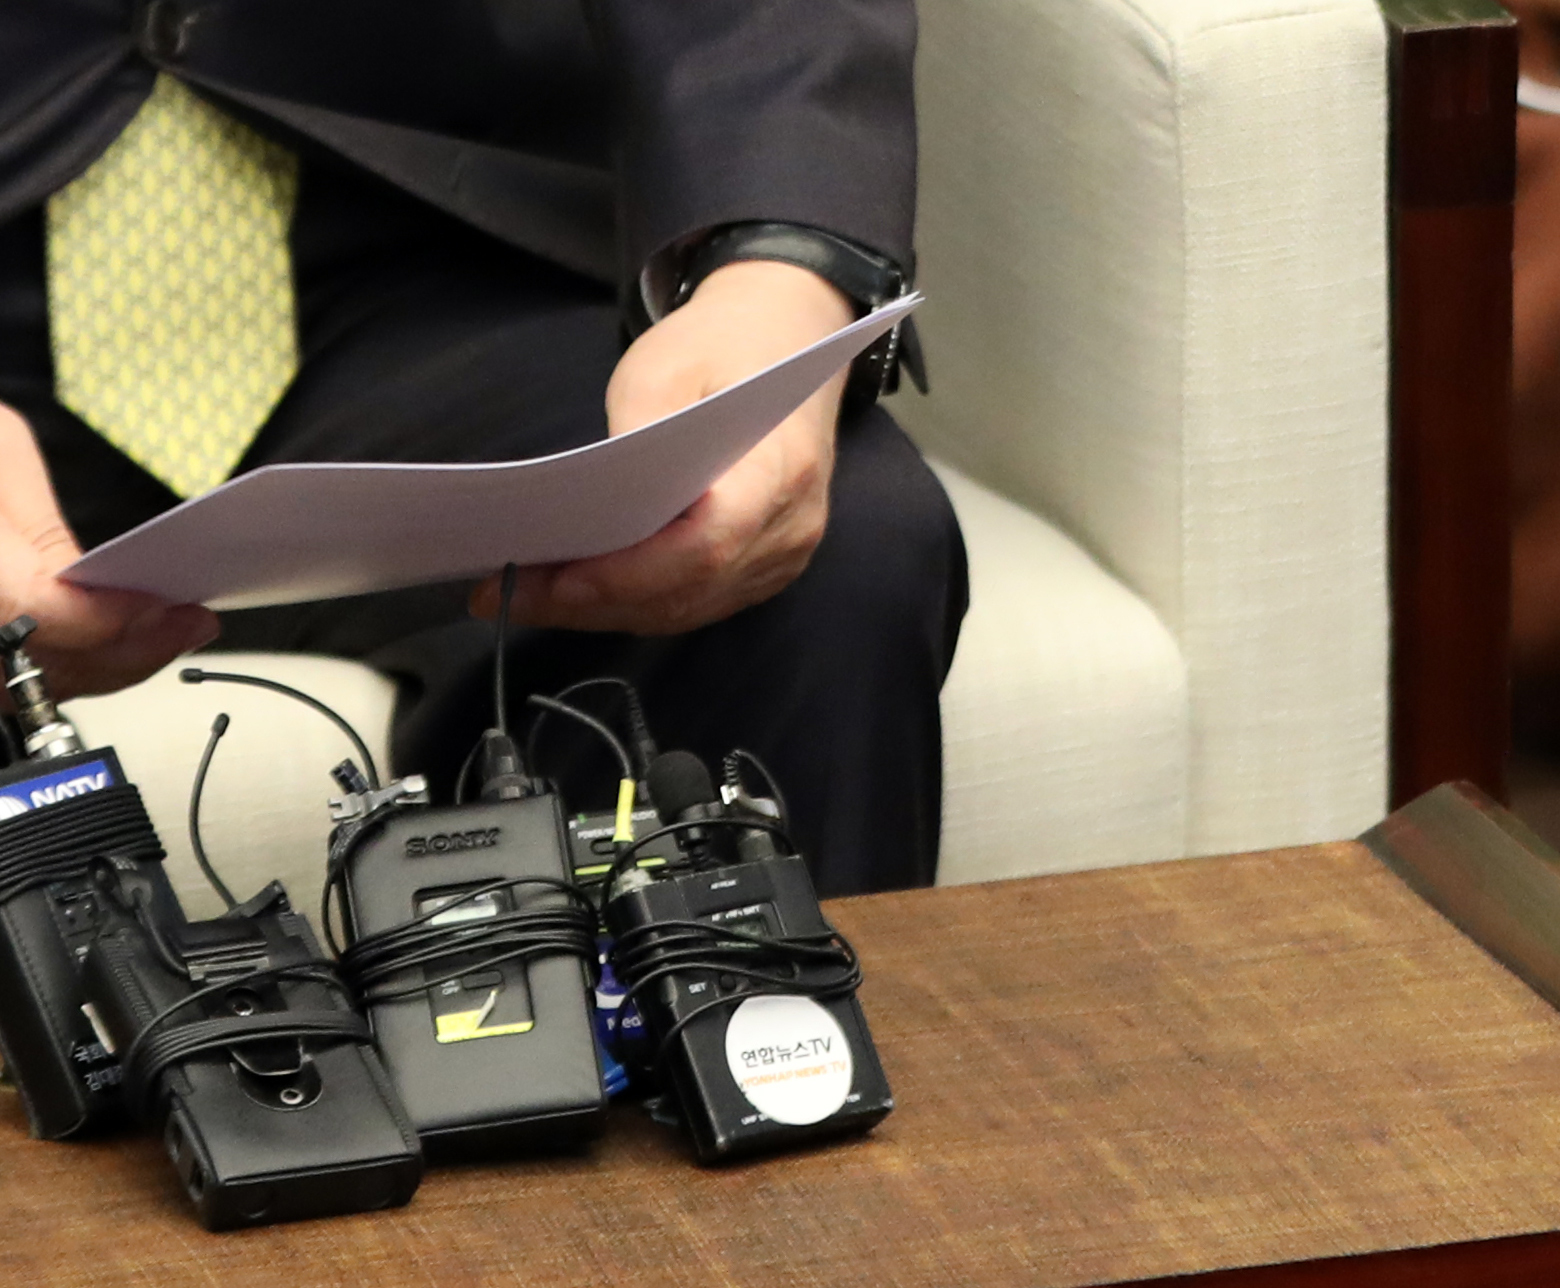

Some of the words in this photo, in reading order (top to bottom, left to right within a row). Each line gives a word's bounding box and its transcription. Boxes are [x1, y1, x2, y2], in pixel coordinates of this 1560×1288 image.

[405, 827, 502, 858] SONY
[740, 1036, 833, 1069] 연합뉴스TV
[742, 1070, 794, 1089] YONHAP
[795, 1064, 828, 1080] NEWS
[829, 1060, 847, 1074] TV
